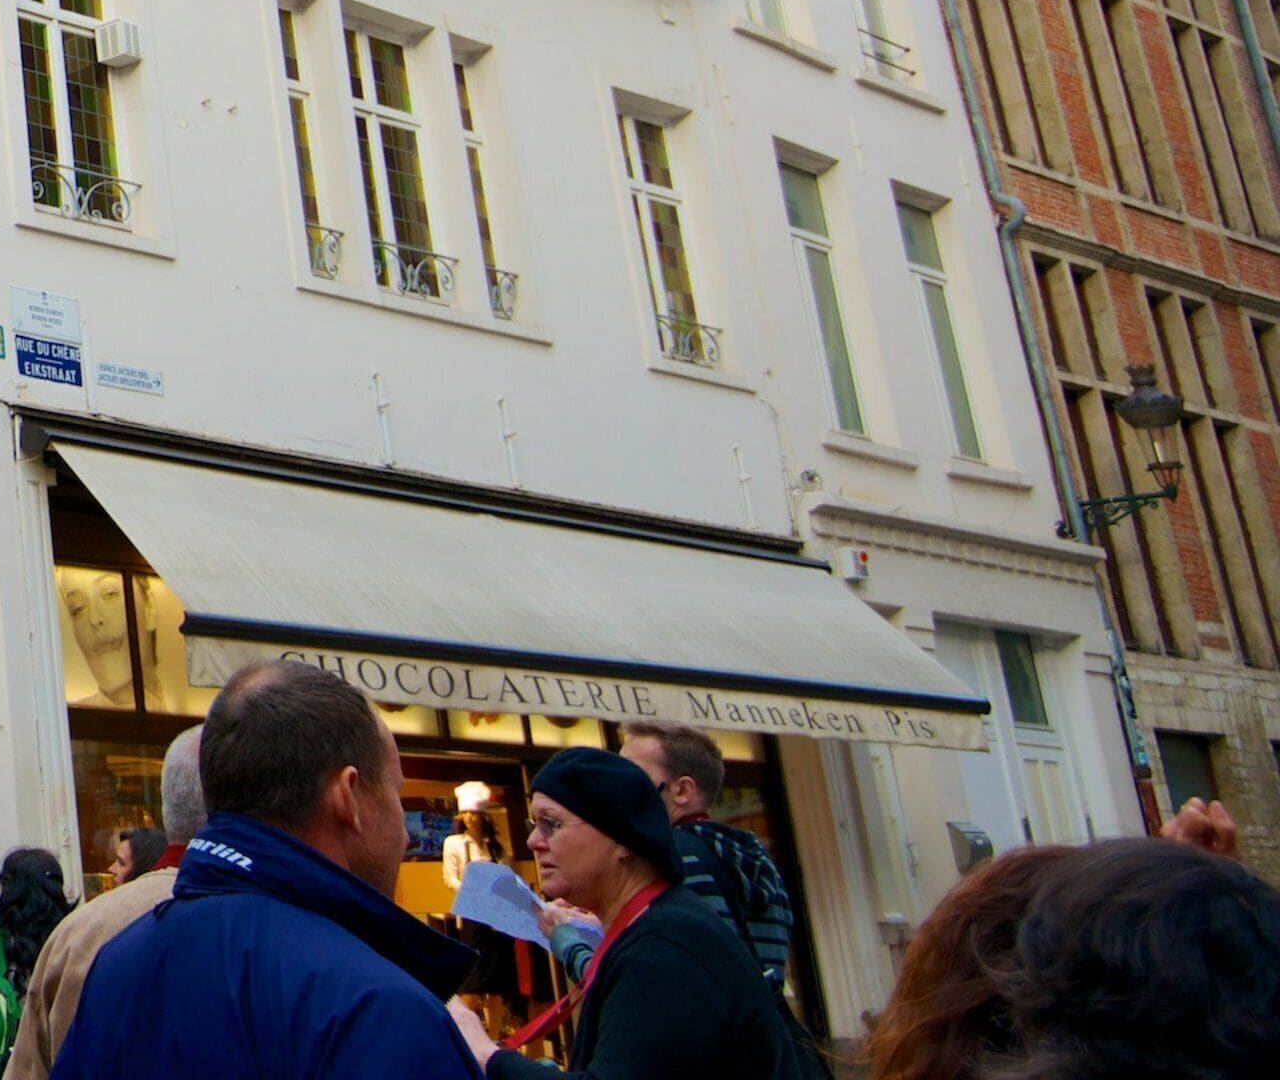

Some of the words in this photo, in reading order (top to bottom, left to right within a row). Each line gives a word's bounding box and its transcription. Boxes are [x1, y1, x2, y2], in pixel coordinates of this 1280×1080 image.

[16, 337, 35, 353] RUE
[37, 341, 50, 356] DU
[24, 361, 77, 383] EIKSTRAAT
[685, 690, 865, 735] Manneken
[885, 709, 936, 740] Pis
[186, 838, 253, 872] arlin
